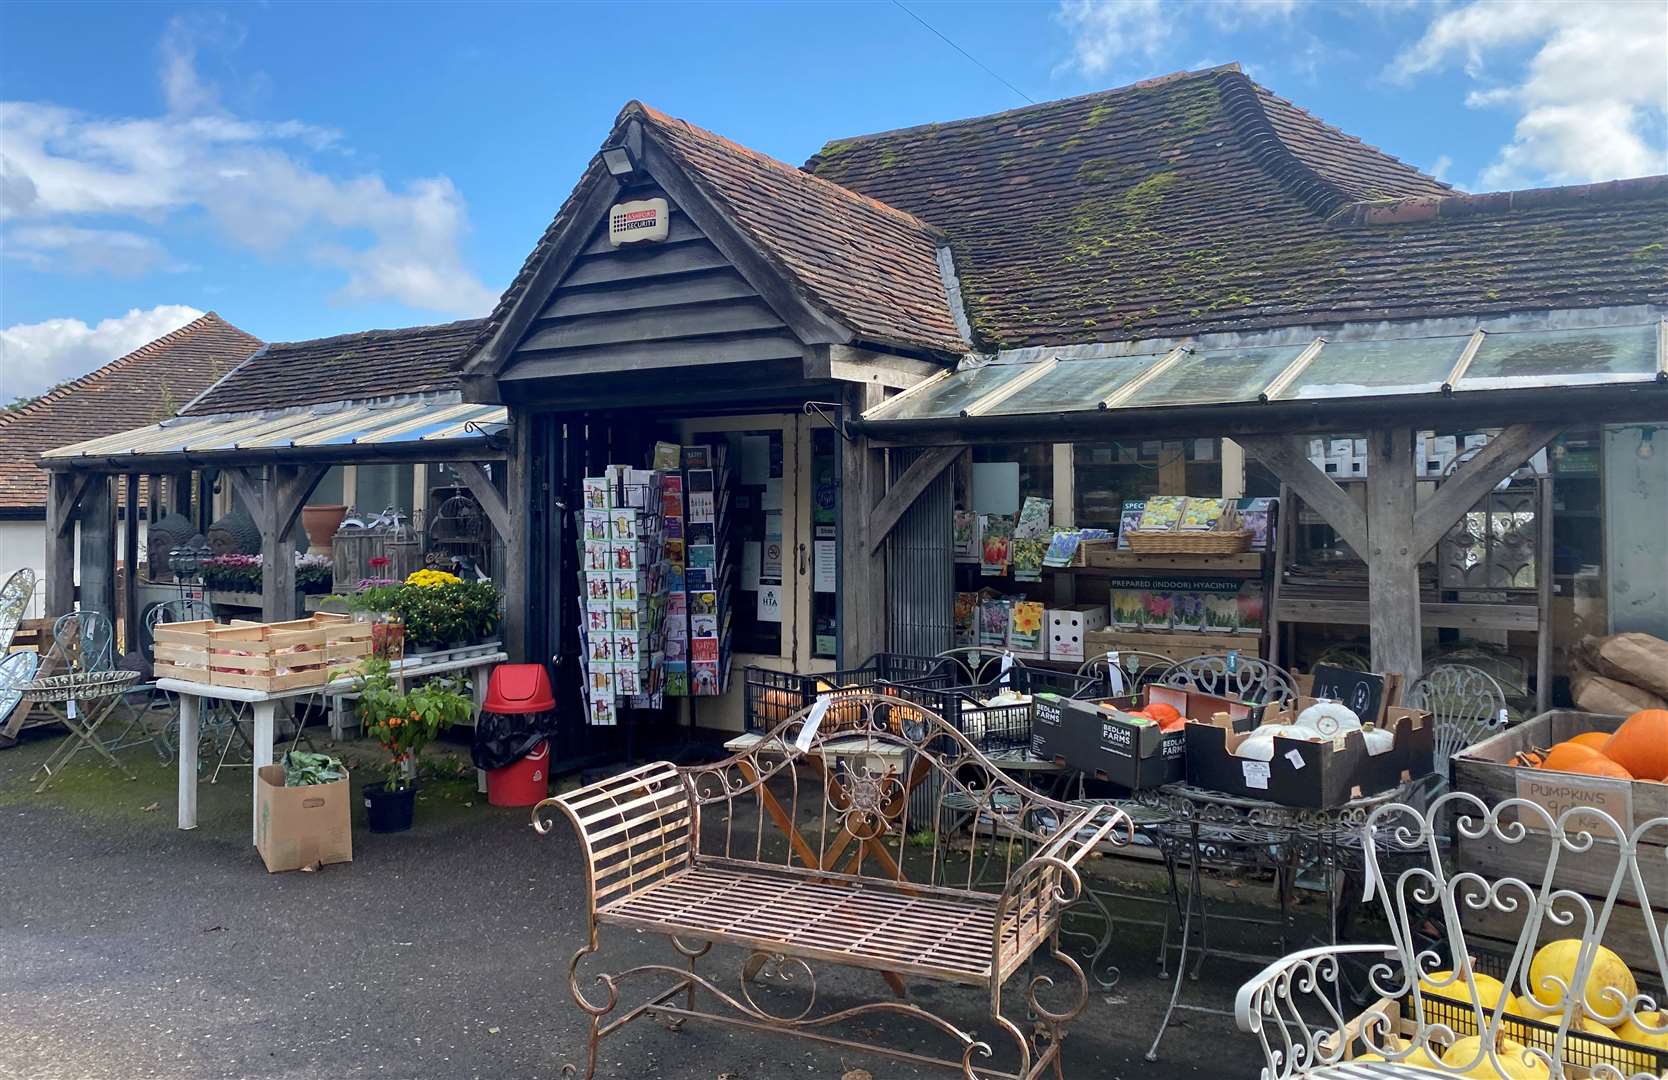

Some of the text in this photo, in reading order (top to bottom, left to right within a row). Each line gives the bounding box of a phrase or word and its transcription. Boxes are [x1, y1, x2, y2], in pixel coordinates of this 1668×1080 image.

[628, 210, 656, 219] ASHFORD
[627, 220, 656, 229] SECURITY
[1111, 579, 1237, 590] PREPARED (INDOOR) HYACINTH
[762, 597, 778, 607] HTA
[1036, 703, 1061, 716] BEDLAM
[1036, 709, 1060, 723] FARMS
[1103, 723, 1131, 737] BEDLAM
[1103, 730, 1131, 745] FARMS
[1162, 745, 1185, 756] FARM
[1530, 783, 1606, 804] PUMPKINS
